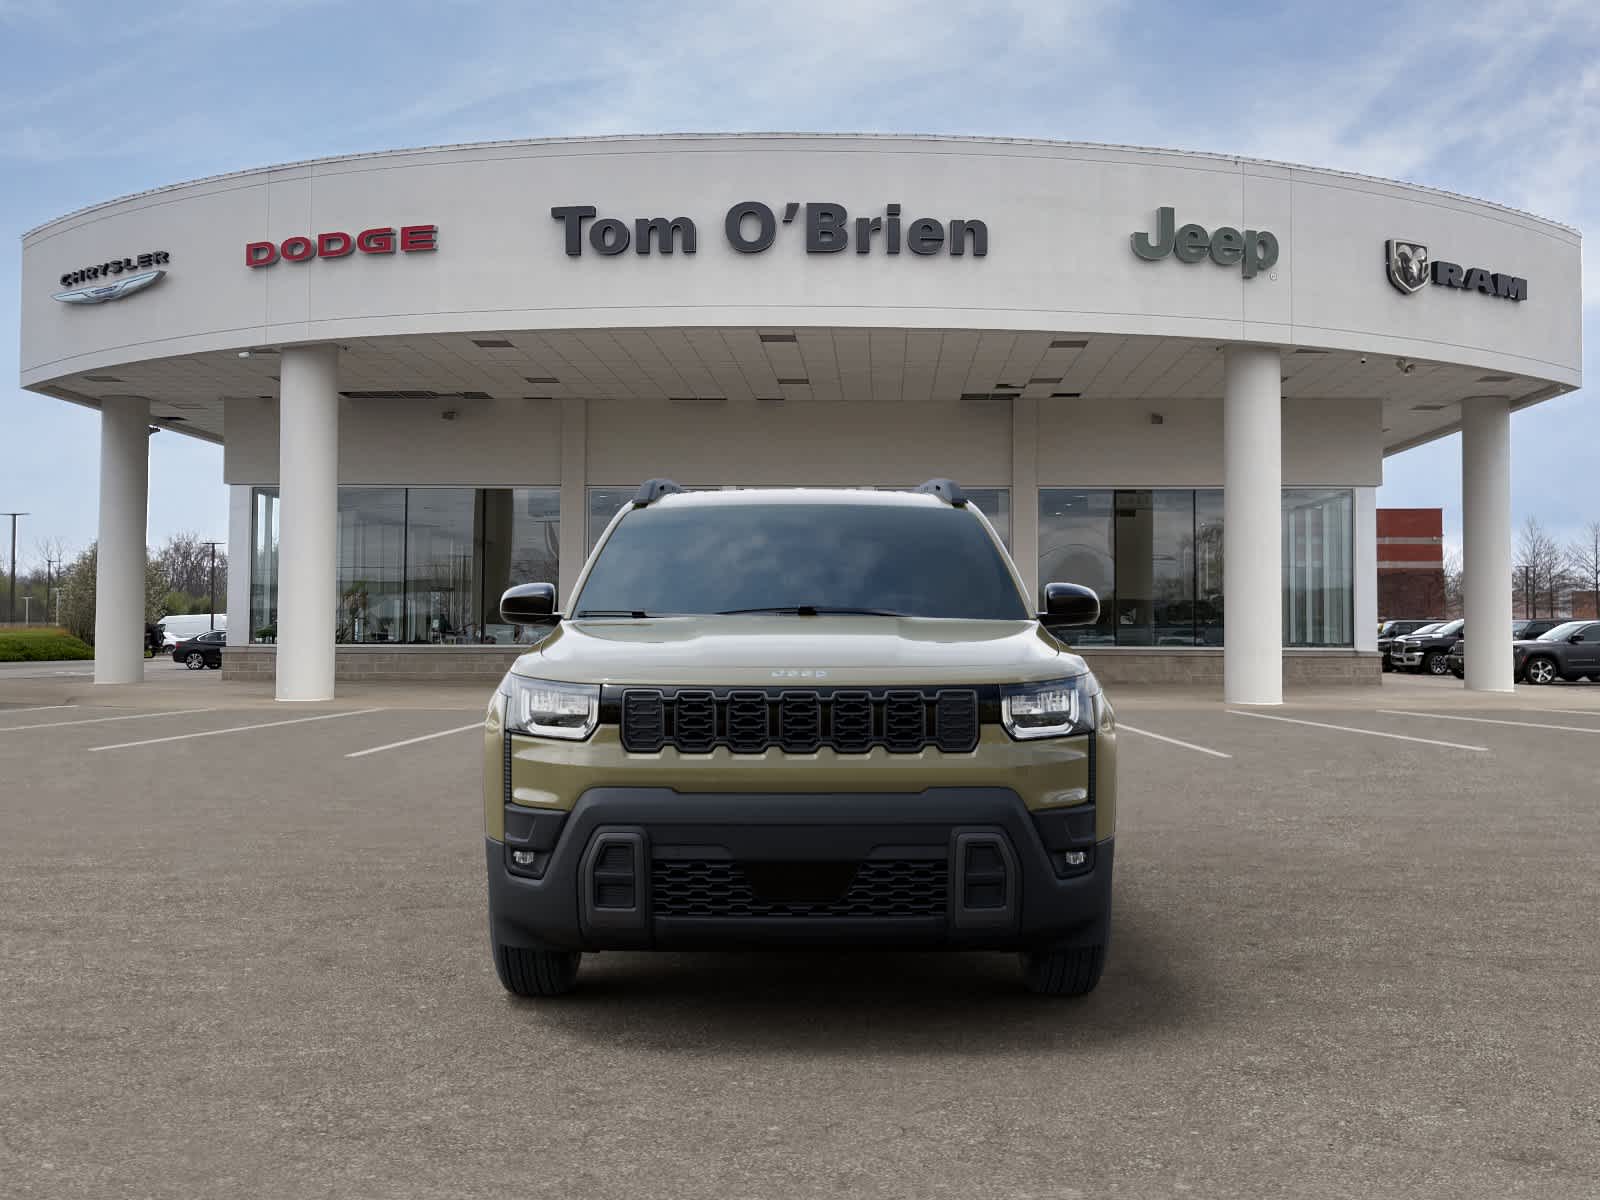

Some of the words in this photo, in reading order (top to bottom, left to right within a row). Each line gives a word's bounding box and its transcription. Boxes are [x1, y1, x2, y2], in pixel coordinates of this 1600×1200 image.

[246, 225, 438, 268] DODGE
[551, 205, 696, 256] Tom
[724, 201, 988, 256] O'Brien
[1130, 206, 1279, 279] Jeep
[60, 251, 169, 287] CHRYSLER
[1431, 260, 1527, 301] RAM
